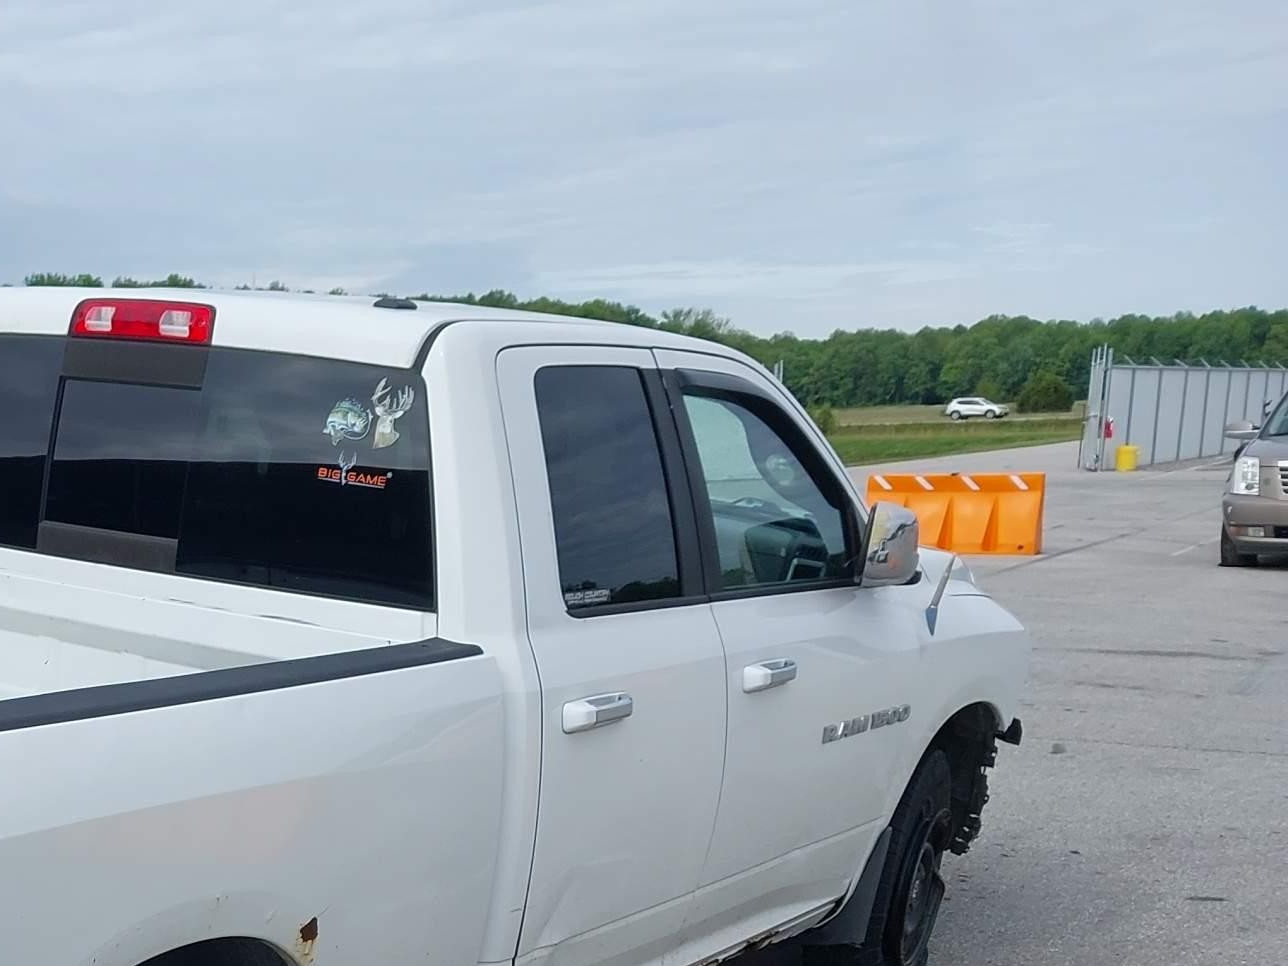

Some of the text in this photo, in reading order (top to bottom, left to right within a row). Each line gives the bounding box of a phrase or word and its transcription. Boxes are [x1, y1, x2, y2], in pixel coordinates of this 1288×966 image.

[317, 467, 387, 486] BIG GAME
[821, 703, 911, 745] RAM 1500
